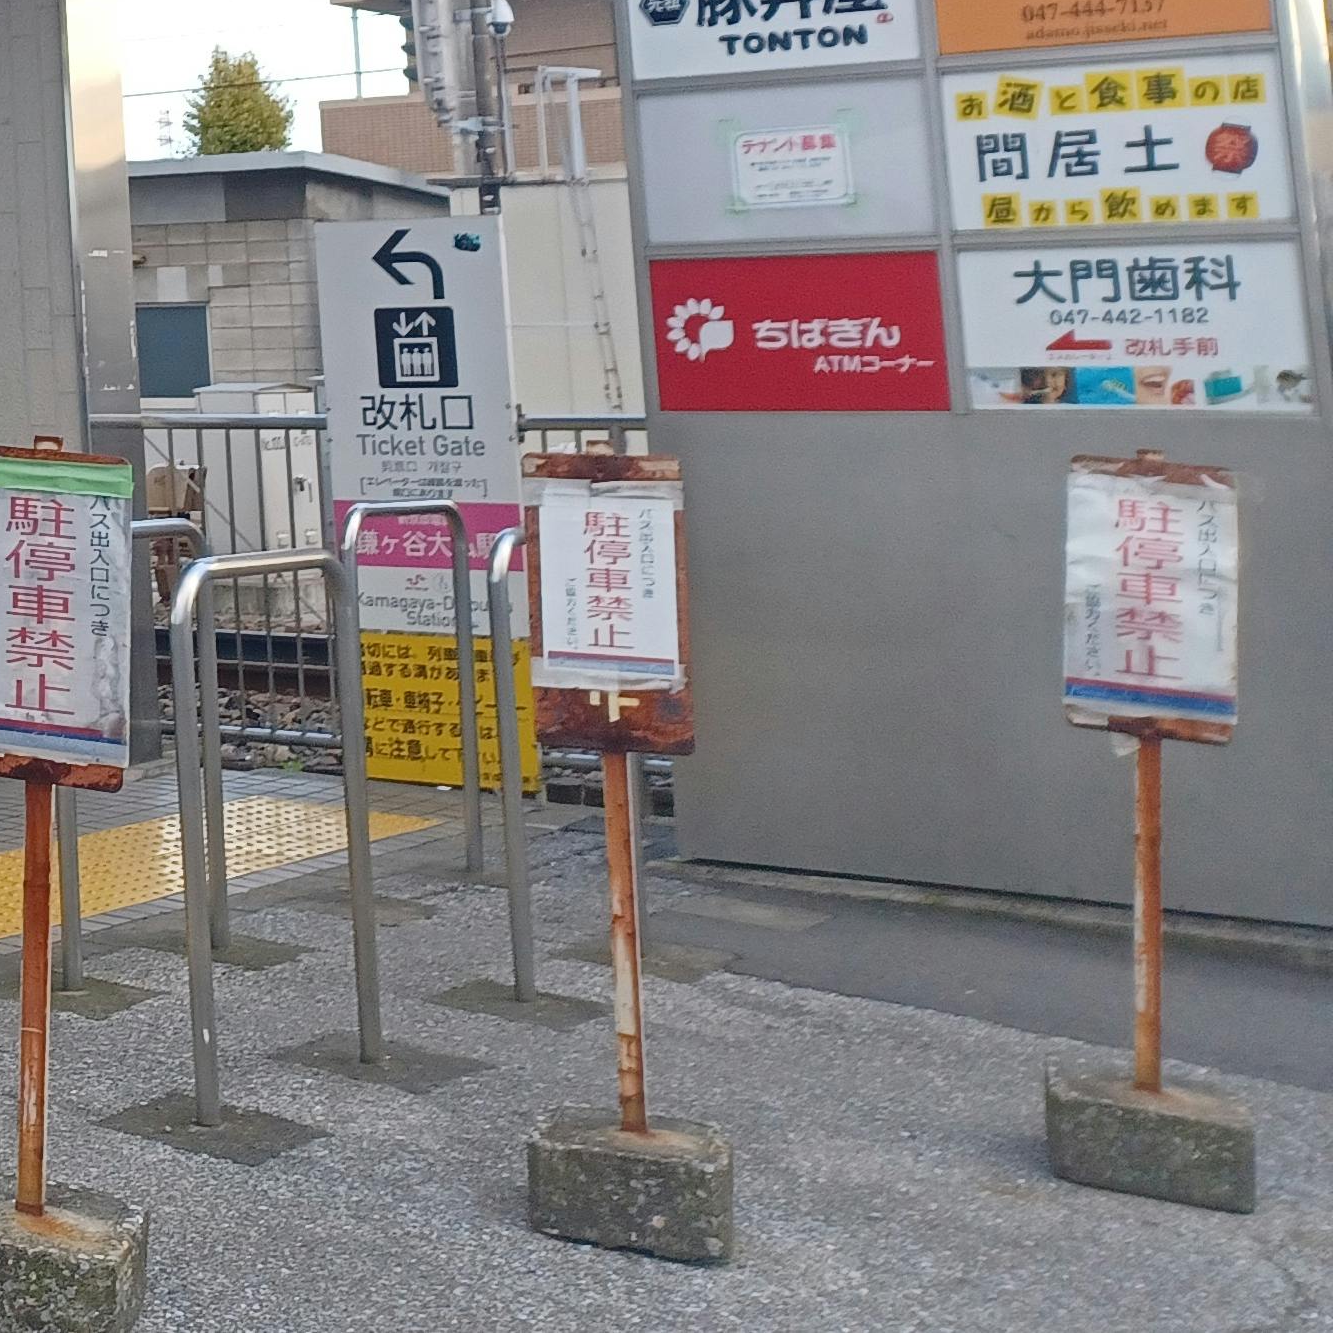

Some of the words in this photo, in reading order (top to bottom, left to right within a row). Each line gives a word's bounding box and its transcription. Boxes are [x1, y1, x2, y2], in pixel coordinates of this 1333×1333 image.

[718, 24, 869, 57] TONTON
[960, 71, 1261, 118] お酒と食事の店
[986, 190, 1255, 225] 昼から飲めます
[1013, 254, 1242, 305] 大門歯科
[752, 316, 902, 350] ちばぎん
[1048, 307, 1210, 326] 047-442-1182
[813, 354, 937, 375] ATMコーナー
[1124, 336, 1220, 358] 改札手前
[359, 392, 475, 431] 改札口
[355, 433, 427, 457] Ticket
[433, 433, 486, 457] Gate
[583, 511, 635, 650] 駐停車禁止
[1115, 498, 1183, 681] 駐停車禁止
[4, 495, 77, 717] 駐停車禁止
